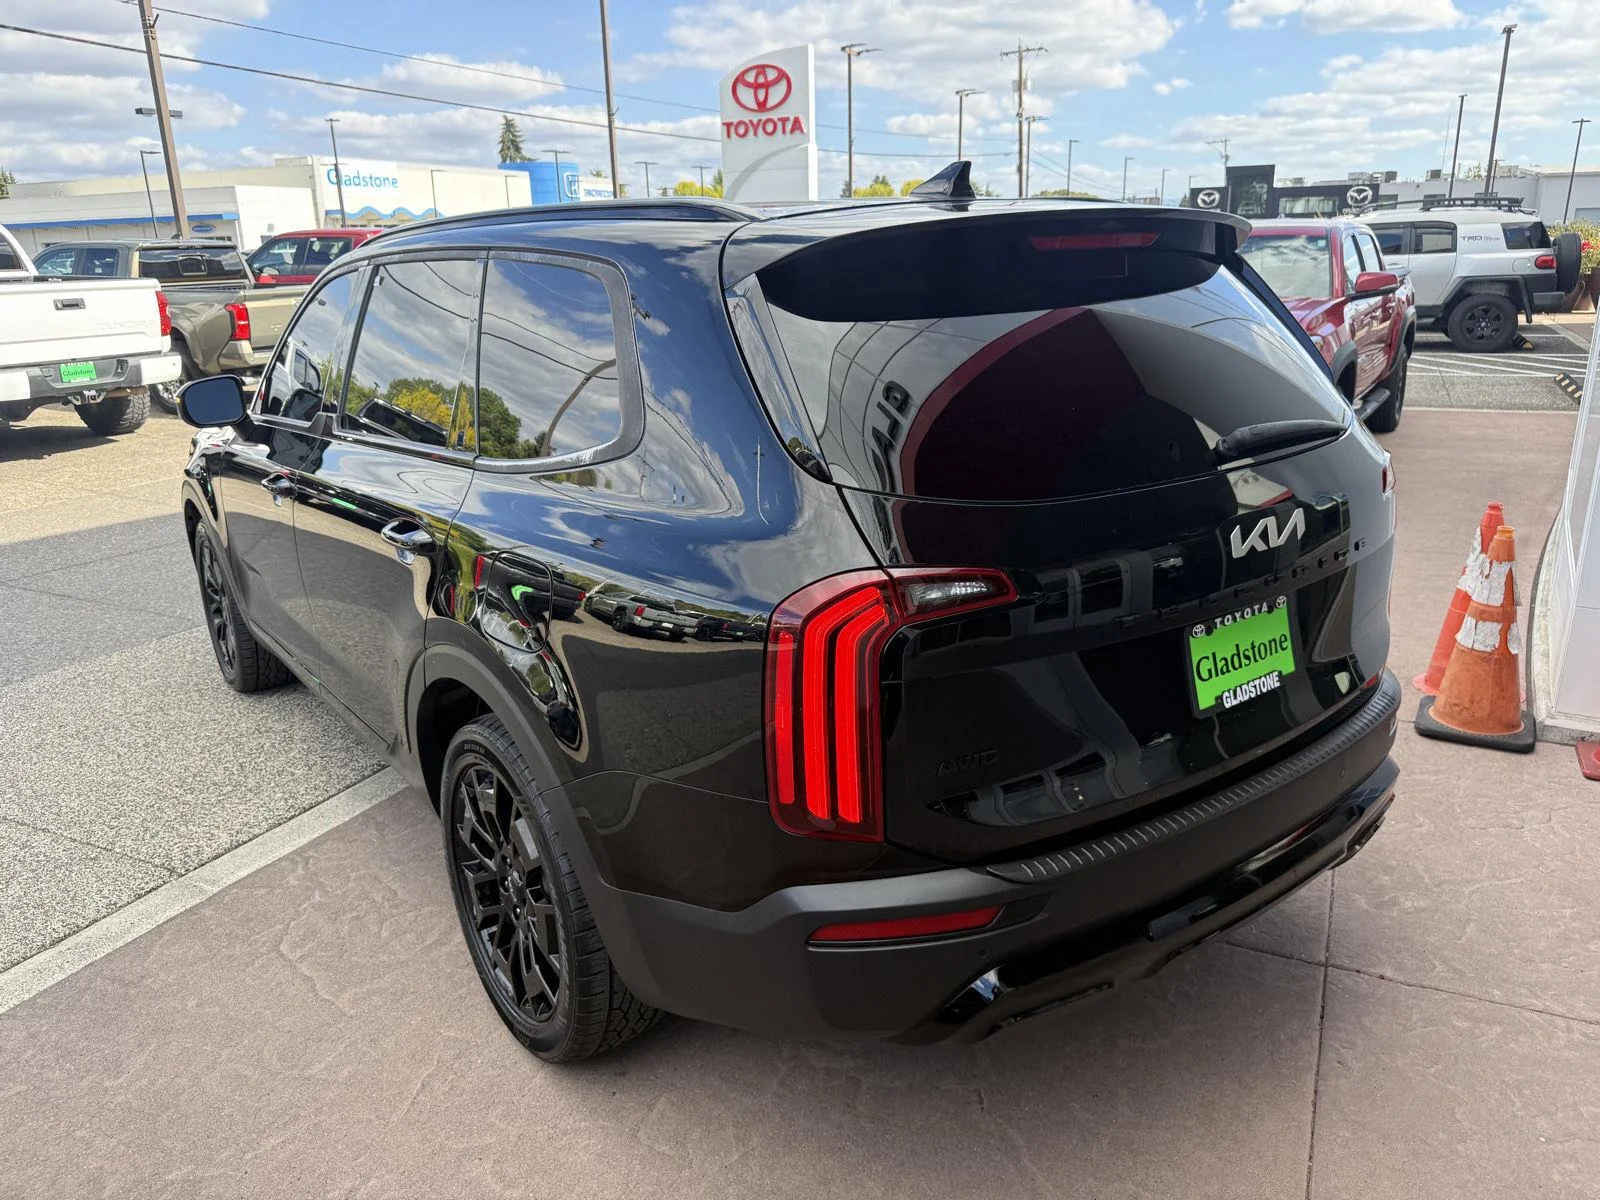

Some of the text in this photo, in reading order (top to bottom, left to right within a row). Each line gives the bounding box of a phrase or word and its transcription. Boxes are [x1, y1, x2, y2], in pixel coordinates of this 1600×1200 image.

[722, 116, 805, 139] TOYOTA
[62, 369, 94, 377] Gladstone
[1230, 508, 1305, 558] KIA
[1215, 602, 1268, 629] TOYOTA
[1195, 633, 1288, 682] Gladstone
[1222, 671, 1280, 709] GLADSTONE
